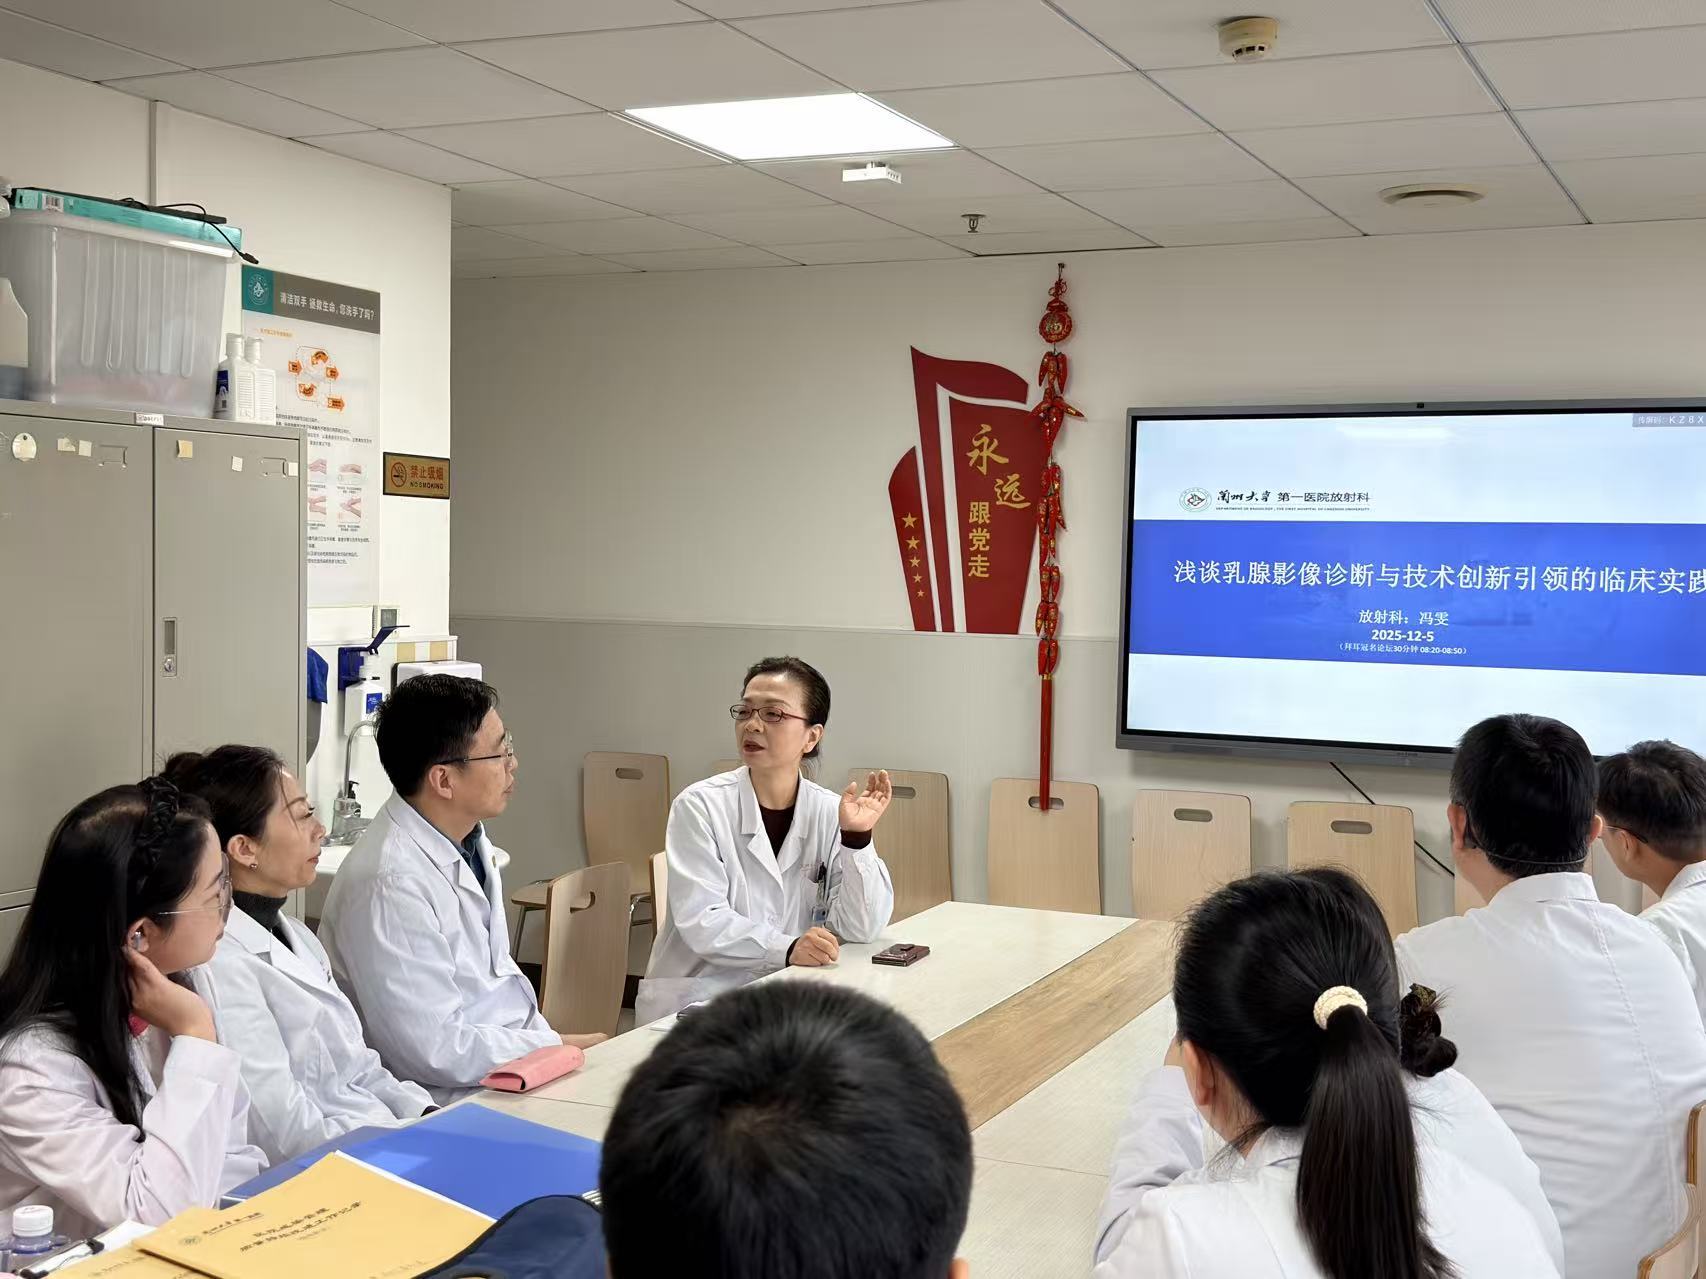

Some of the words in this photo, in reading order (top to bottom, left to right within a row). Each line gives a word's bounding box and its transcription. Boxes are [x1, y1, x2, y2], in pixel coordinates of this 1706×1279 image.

[410, 465, 444, 480] 禁止吸烟
[1277, 492, 1370, 503] 第一医院放射科
[968, 501, 991, 578] 跟党走
[1173, 559, 1706, 594] 浅谈乳腺影像诊断与技术创新引领的临床实践
[1371, 629, 1435, 642] 2025-12-5
